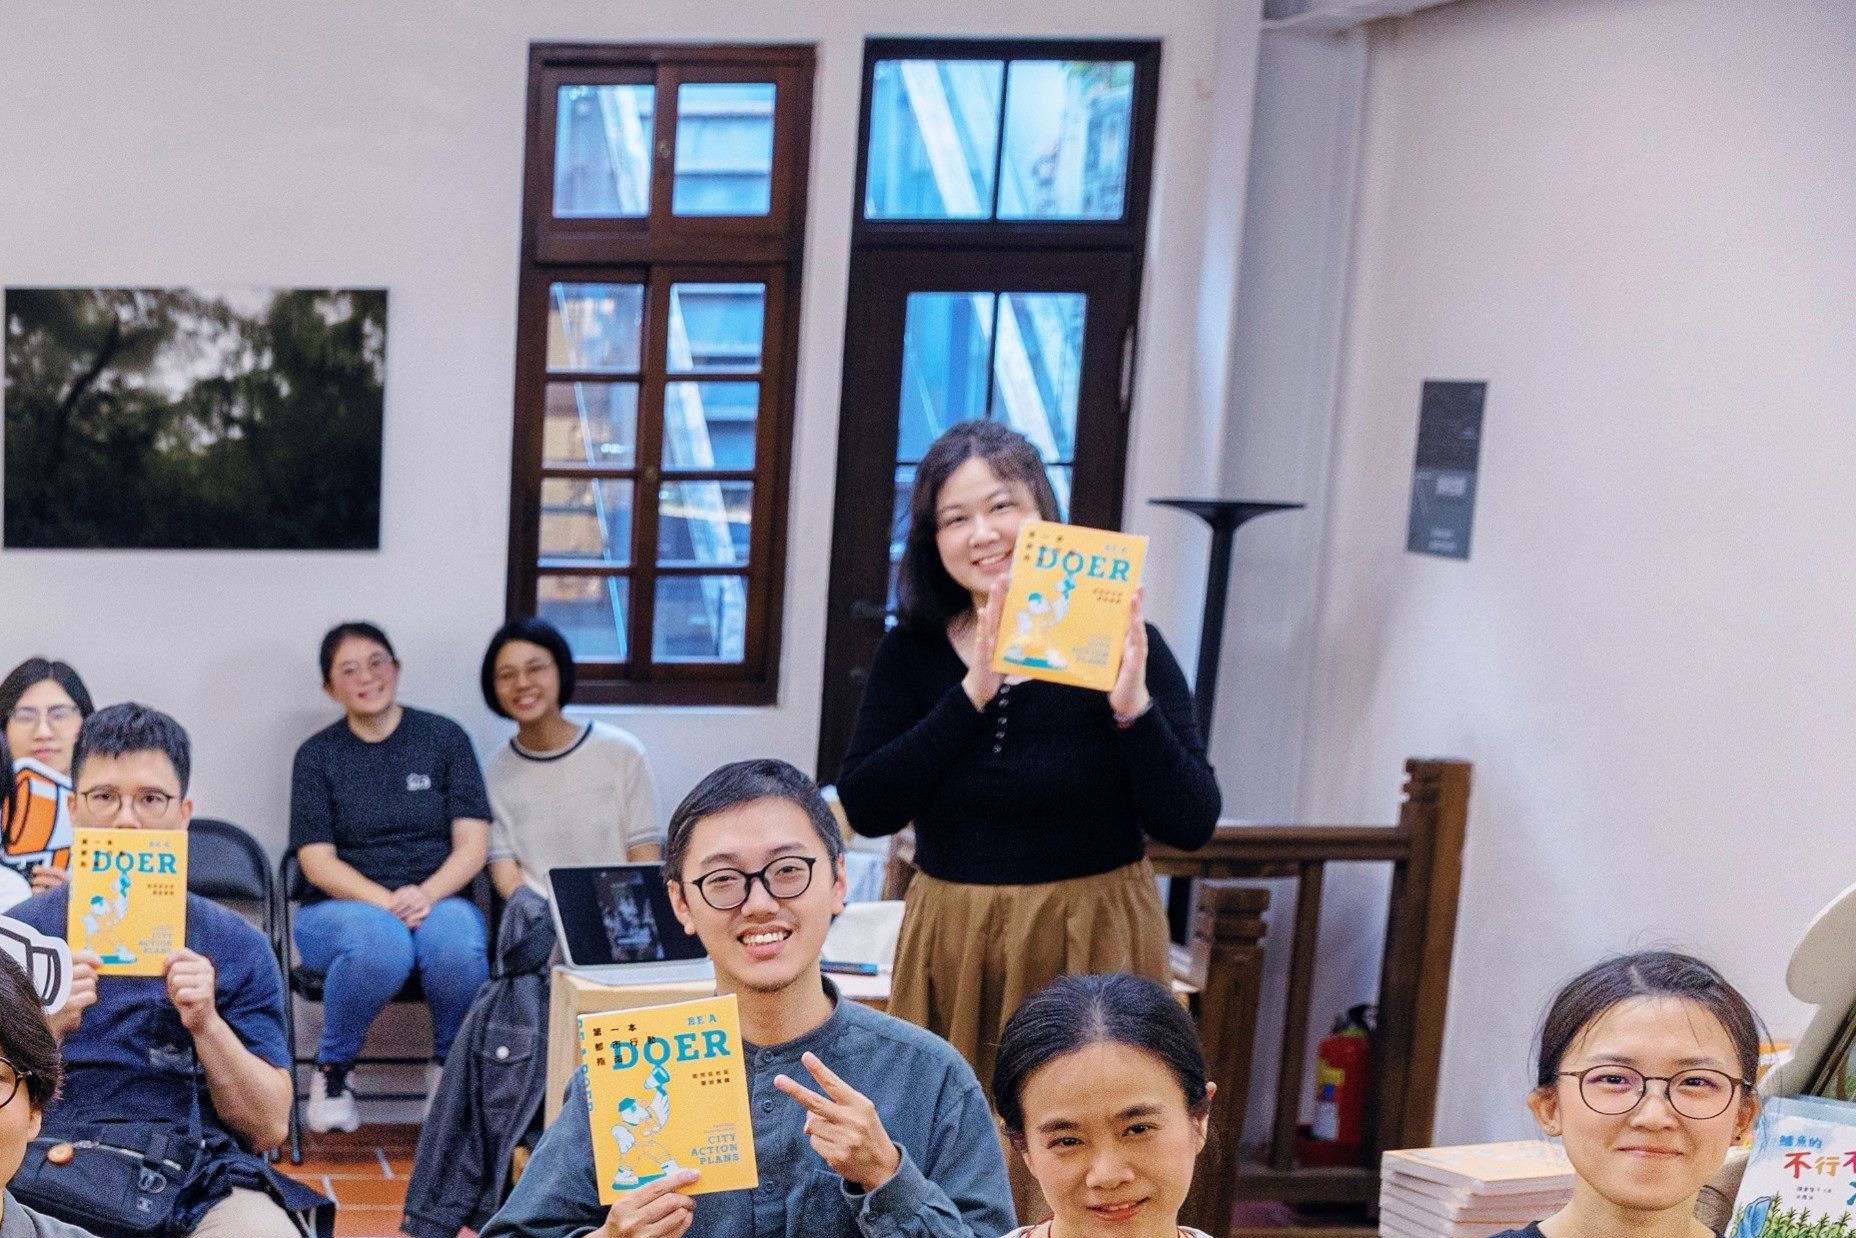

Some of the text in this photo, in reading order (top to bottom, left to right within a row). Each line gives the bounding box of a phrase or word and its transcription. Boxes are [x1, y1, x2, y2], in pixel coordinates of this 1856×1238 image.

[1035, 545, 1131, 581] DOER
[91, 850, 177, 875] DOER
[687, 1014, 718, 1026] BE A
[609, 1028, 731, 1071] DOER
[708, 1133, 736, 1145] CITY
[691, 1143, 737, 1156] ACTION
[699, 1153, 740, 1165] PLANS
